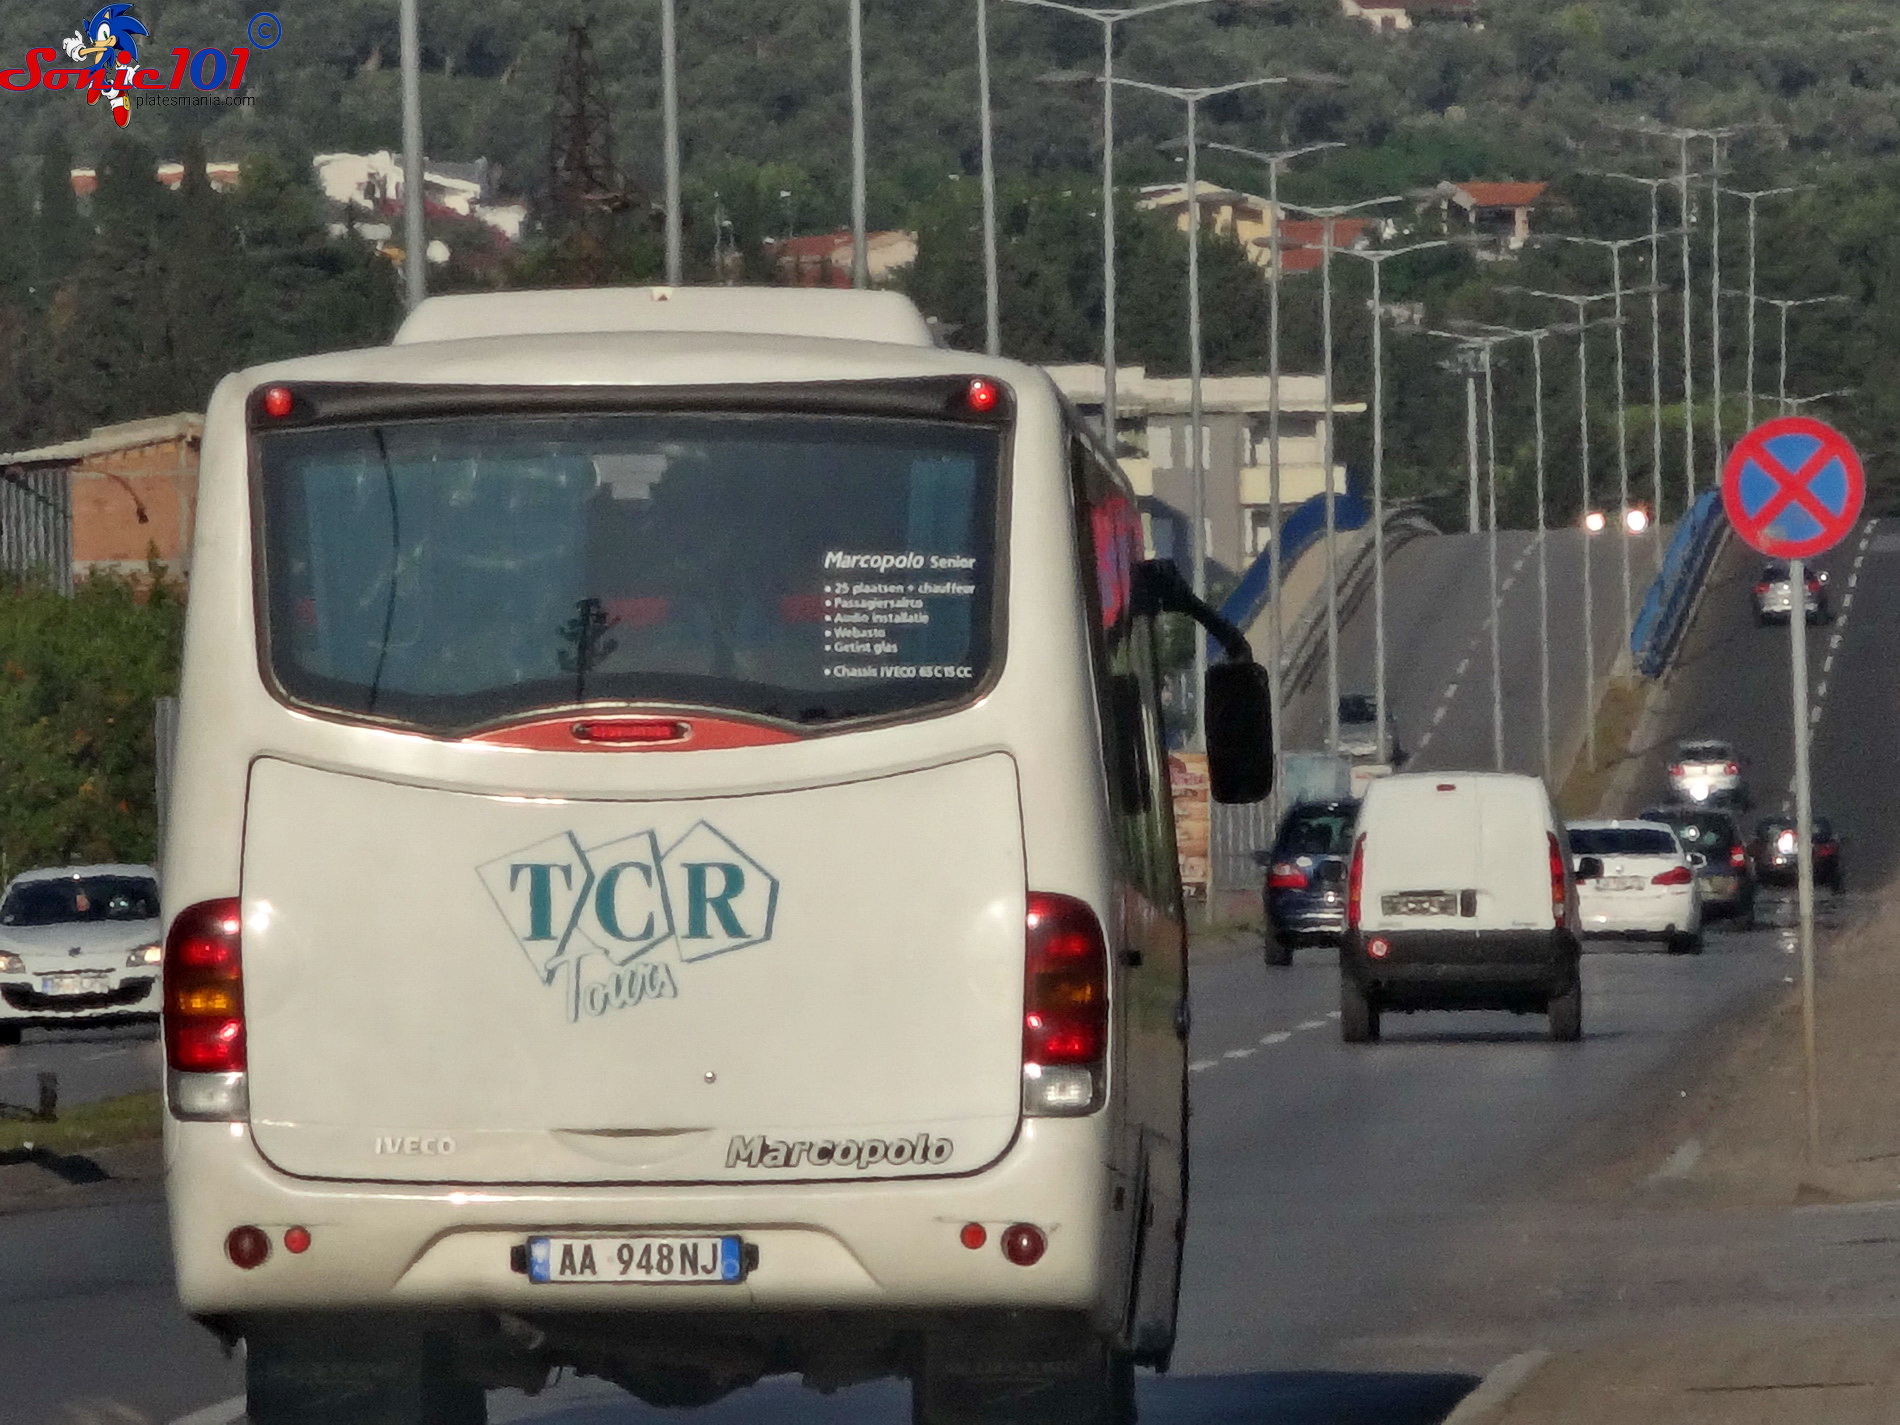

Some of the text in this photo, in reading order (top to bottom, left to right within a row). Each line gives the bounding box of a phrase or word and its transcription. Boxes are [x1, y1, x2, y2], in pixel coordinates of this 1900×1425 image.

[824, 551, 976, 573] Marcopolo Senior
[852, 582, 904, 595] plaatsen
[918, 582, 976, 594] chauffeur
[834, 612, 869, 623] Audio
[834, 628, 886, 638] Webasto
[834, 641, 898, 655] Getint glas
[833, 665, 878, 677] Chassis
[880, 666, 917, 678] IVECO
[509, 861, 752, 942] TCR
[544, 952, 678, 1023] Tours
[375, 1136, 456, 1155] IVECO
[725, 1133, 954, 1169] Marcopolo
[559, 1243, 597, 1275] AA
